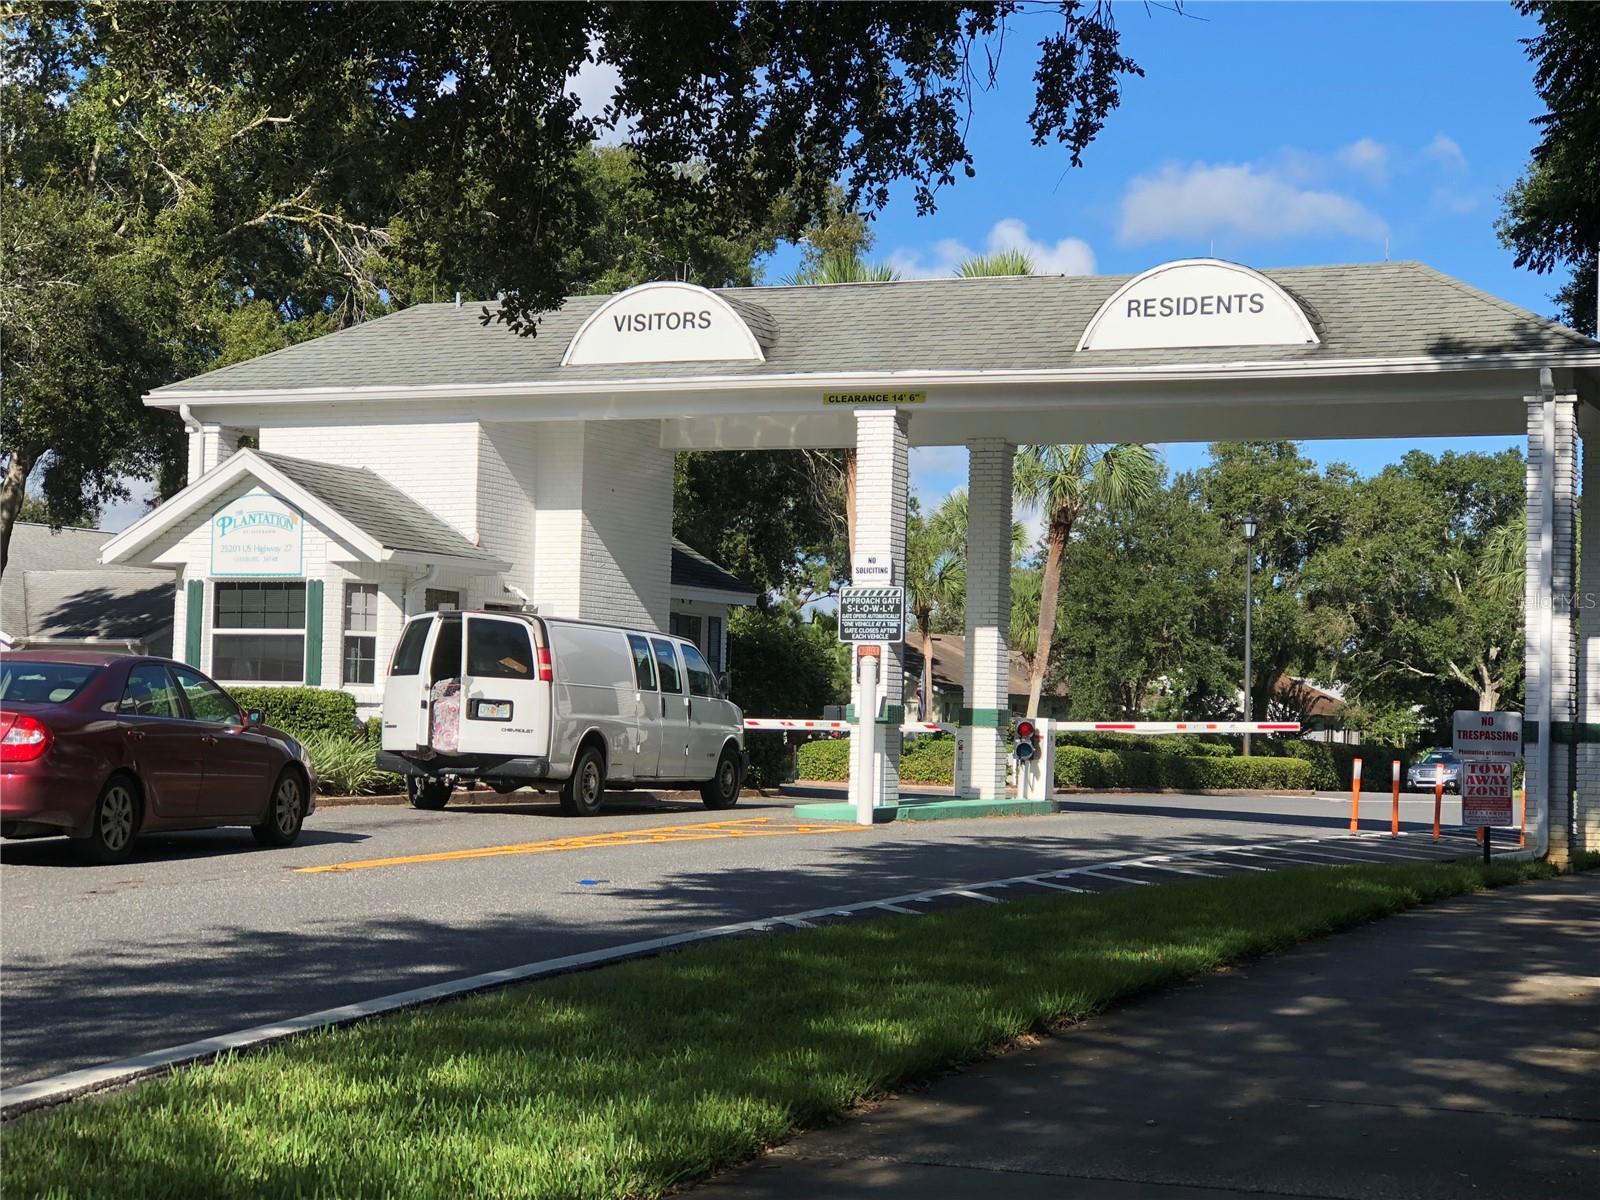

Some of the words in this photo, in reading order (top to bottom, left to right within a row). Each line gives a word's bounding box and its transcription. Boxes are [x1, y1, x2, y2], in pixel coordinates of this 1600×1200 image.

[1127, 293, 1265, 318] RESIDENTS
[613, 311, 712, 333] VISITORS
[828, 394, 889, 403] CLEARANCE
[891, 393, 906, 402] 14'
[909, 393, 920, 402] 6"
[216, 512, 294, 537] PLANTATION
[1481, 716, 1494, 726] NO
[1457, 730, 1519, 741] TRESPASSING
[1468, 764, 1507, 774] TOW
[1466, 775, 1510, 785] AWAY
[1467, 786, 1508, 796] ZONE
